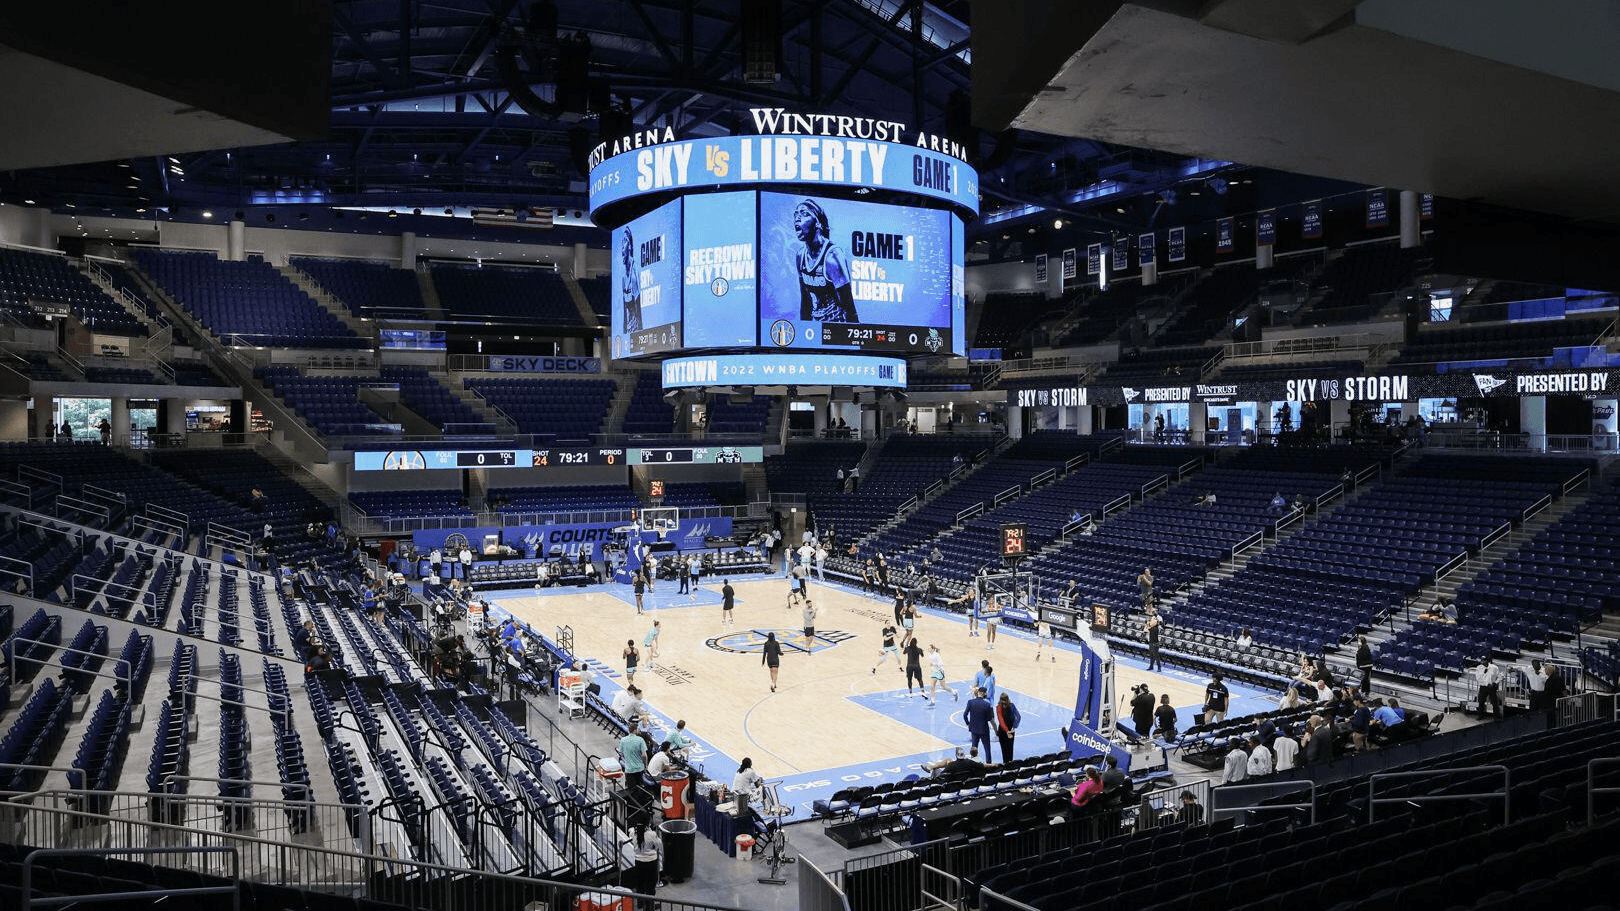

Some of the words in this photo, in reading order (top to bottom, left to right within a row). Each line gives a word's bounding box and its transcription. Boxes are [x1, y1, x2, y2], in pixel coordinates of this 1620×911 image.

[612, 125, 675, 157] ARENA
[916, 131, 967, 162] ARENA
[637, 142, 693, 191] SKY
[740, 137, 888, 185] LIBERTY
[913, 154, 951, 194] GAME
[953, 165, 958, 196] 1
[640, 236, 660, 267] GAME
[852, 230, 904, 260] GAME
[906, 235, 914, 262] 1
[851, 260, 878, 280] SKY
[851, 281, 904, 303] LIBERTY
[805, 328, 815, 340] 0
[847, 329, 873, 339] 79:21
[908, 333, 918, 345] 0
[503, 358, 538, 370] SKY
[542, 359, 589, 371] DECK
[723, 365, 755, 375] 2022
[763, 365, 806, 375] WNBA
[814, 365, 876, 375] PLAYOFFS
[879, 365, 893, 379] GAME
[1287, 379, 1317, 401] SKY
[1345, 376, 1407, 400] STORM
[1479, 377, 1492, 386] FAN
[1517, 373, 1588, 392] PRESENTED
[1591, 373, 1608, 390] BY
[1018, 389, 1036, 407] SKY
[1051, 388, 1087, 406] STORM
[1145, 388, 1181, 401] PRESENTED
[1182, 387, 1191, 400] BY
[478, 454, 485, 464] 0
[534, 456, 547, 466] 24
[559, 453, 588, 463] 79:21
[608, 455, 615, 464] 0
[666, 452, 673, 461] 0
[651, 486, 664, 496] 24
[1006, 538, 1022, 553] 24
[1048, 611, 1066, 623] Google
[1072, 732, 1112, 754] coinbase
[661, 785, 674, 810] G
